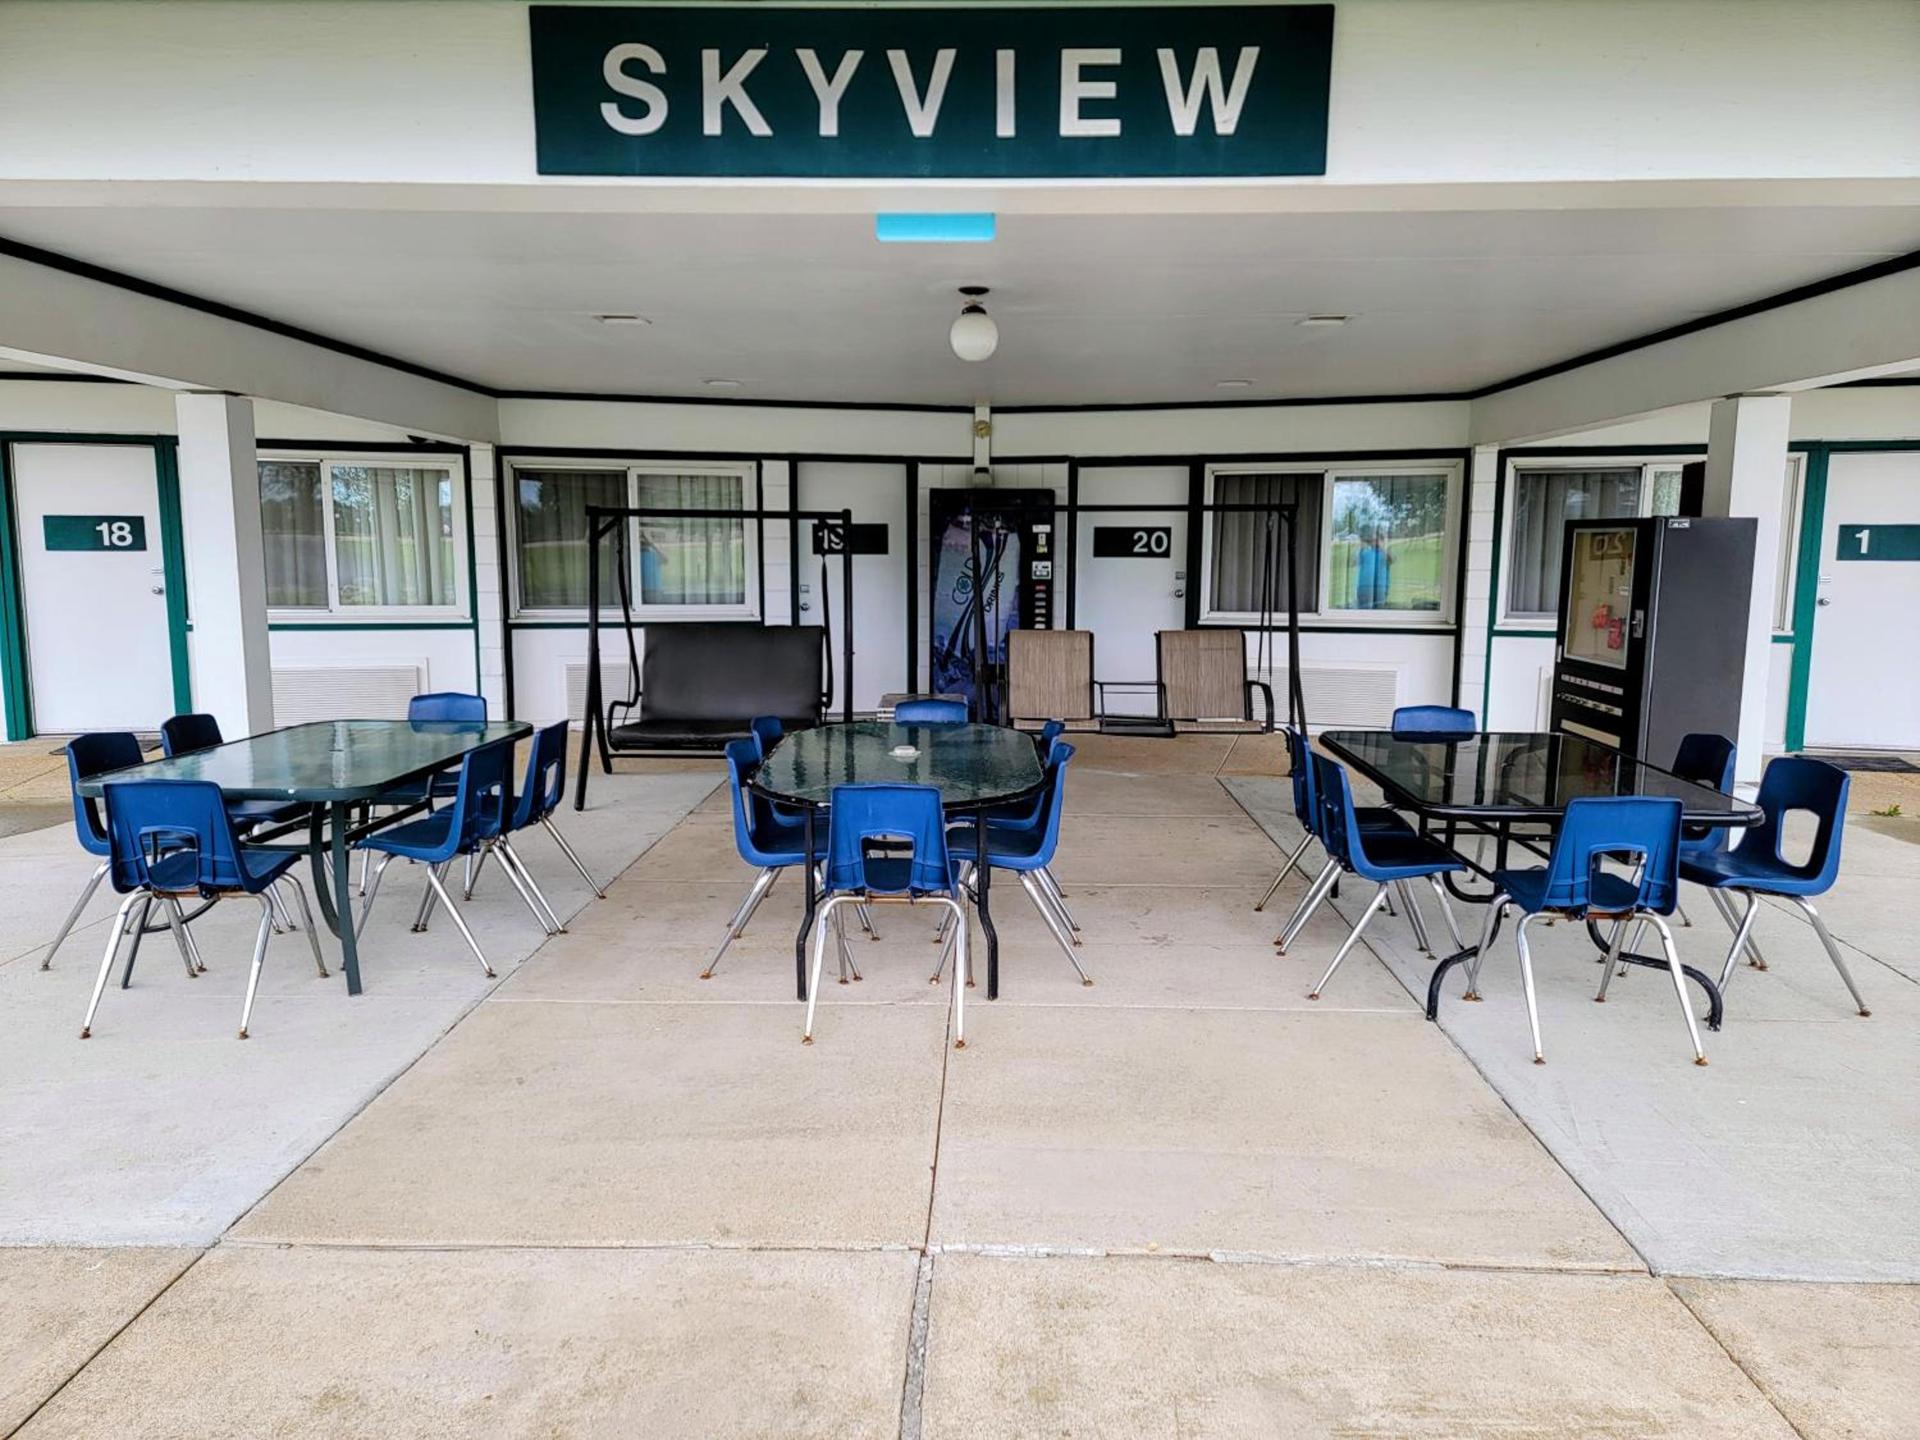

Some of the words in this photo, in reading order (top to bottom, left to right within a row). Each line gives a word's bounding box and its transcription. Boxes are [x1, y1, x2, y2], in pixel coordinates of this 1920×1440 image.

[600, 42, 1260, 137] SKYVIEW
[96, 521, 133, 547] 18
[1133, 530, 1169, 553] 20
[1855, 529, 1870, 554] 1
